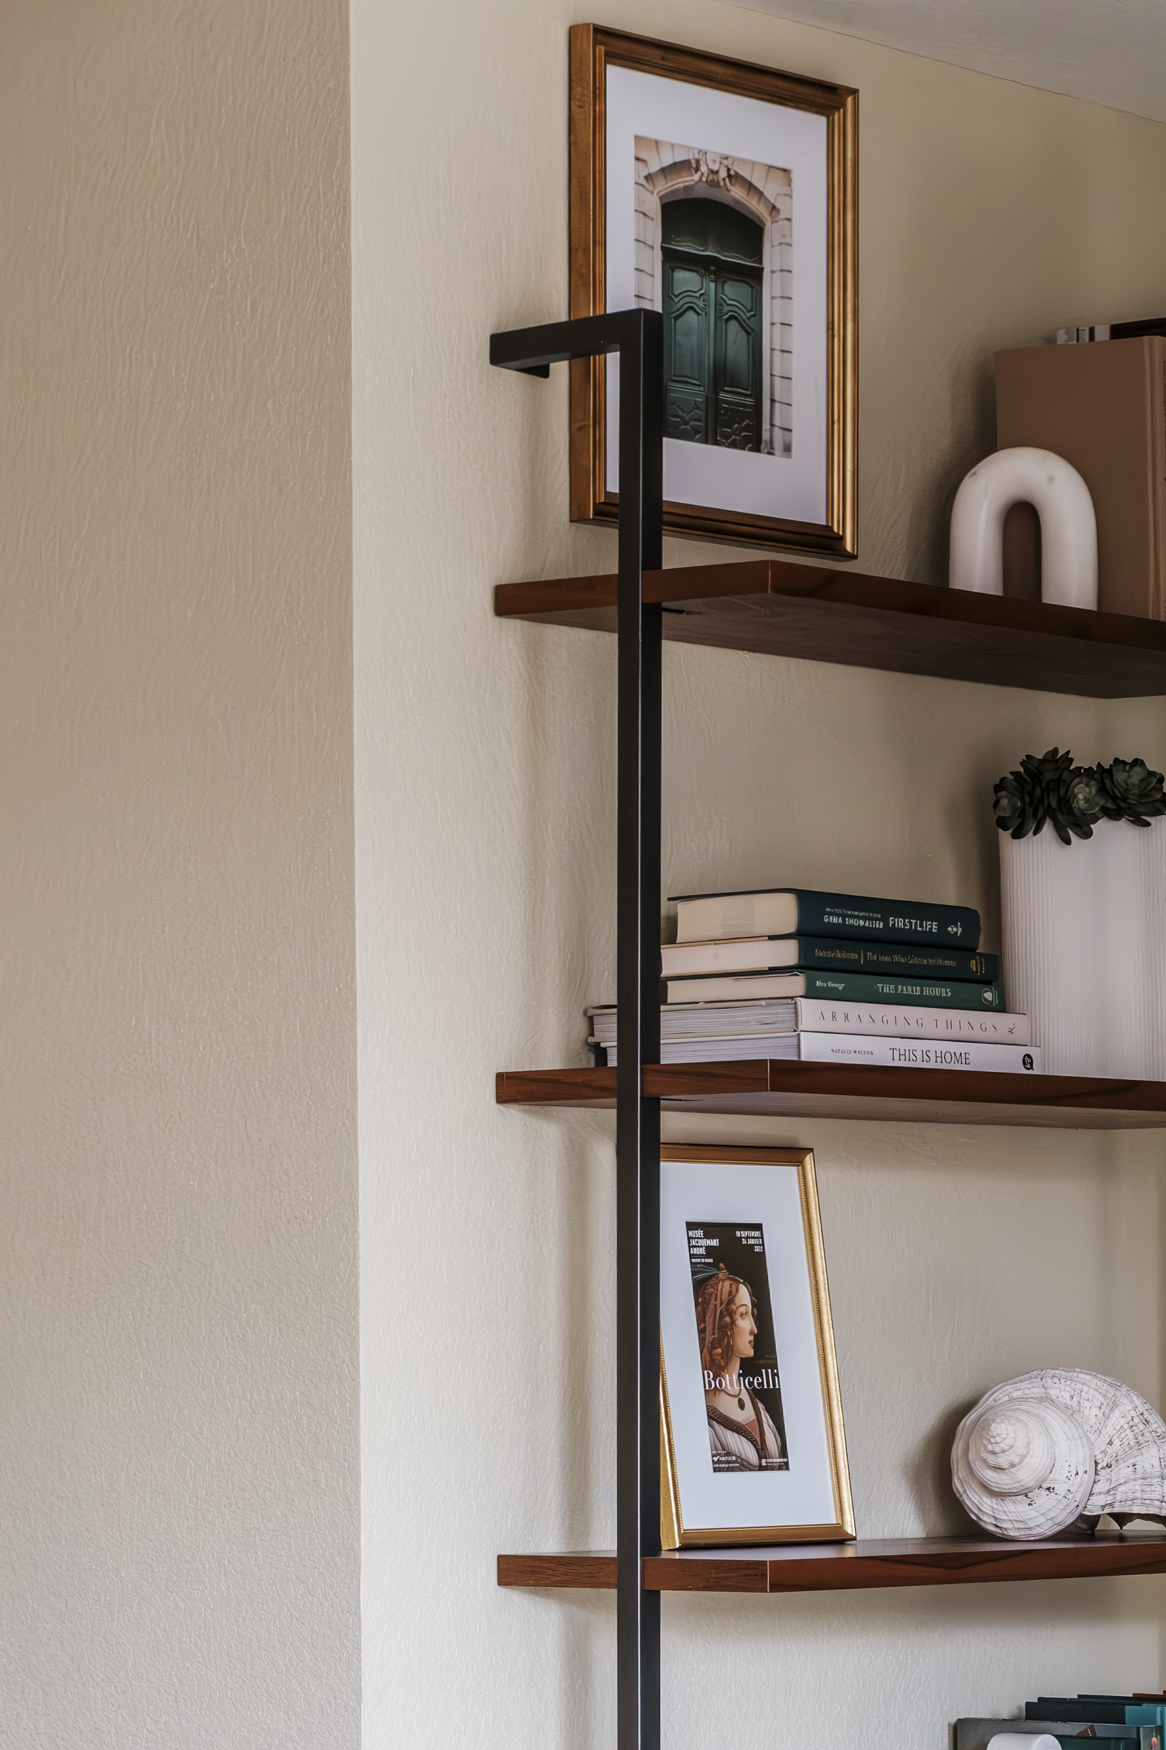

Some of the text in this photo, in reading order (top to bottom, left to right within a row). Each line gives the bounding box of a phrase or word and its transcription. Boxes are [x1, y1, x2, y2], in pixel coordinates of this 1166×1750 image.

[889, 916, 938, 933] FIRSTLIFE
[923, 985, 951, 997] HOURS
[818, 1010, 998, 1034] ARRANGING THINGS
[889, 1047, 971, 1066] THIS IS HOME
[703, 1368, 780, 1391] Botticelli
